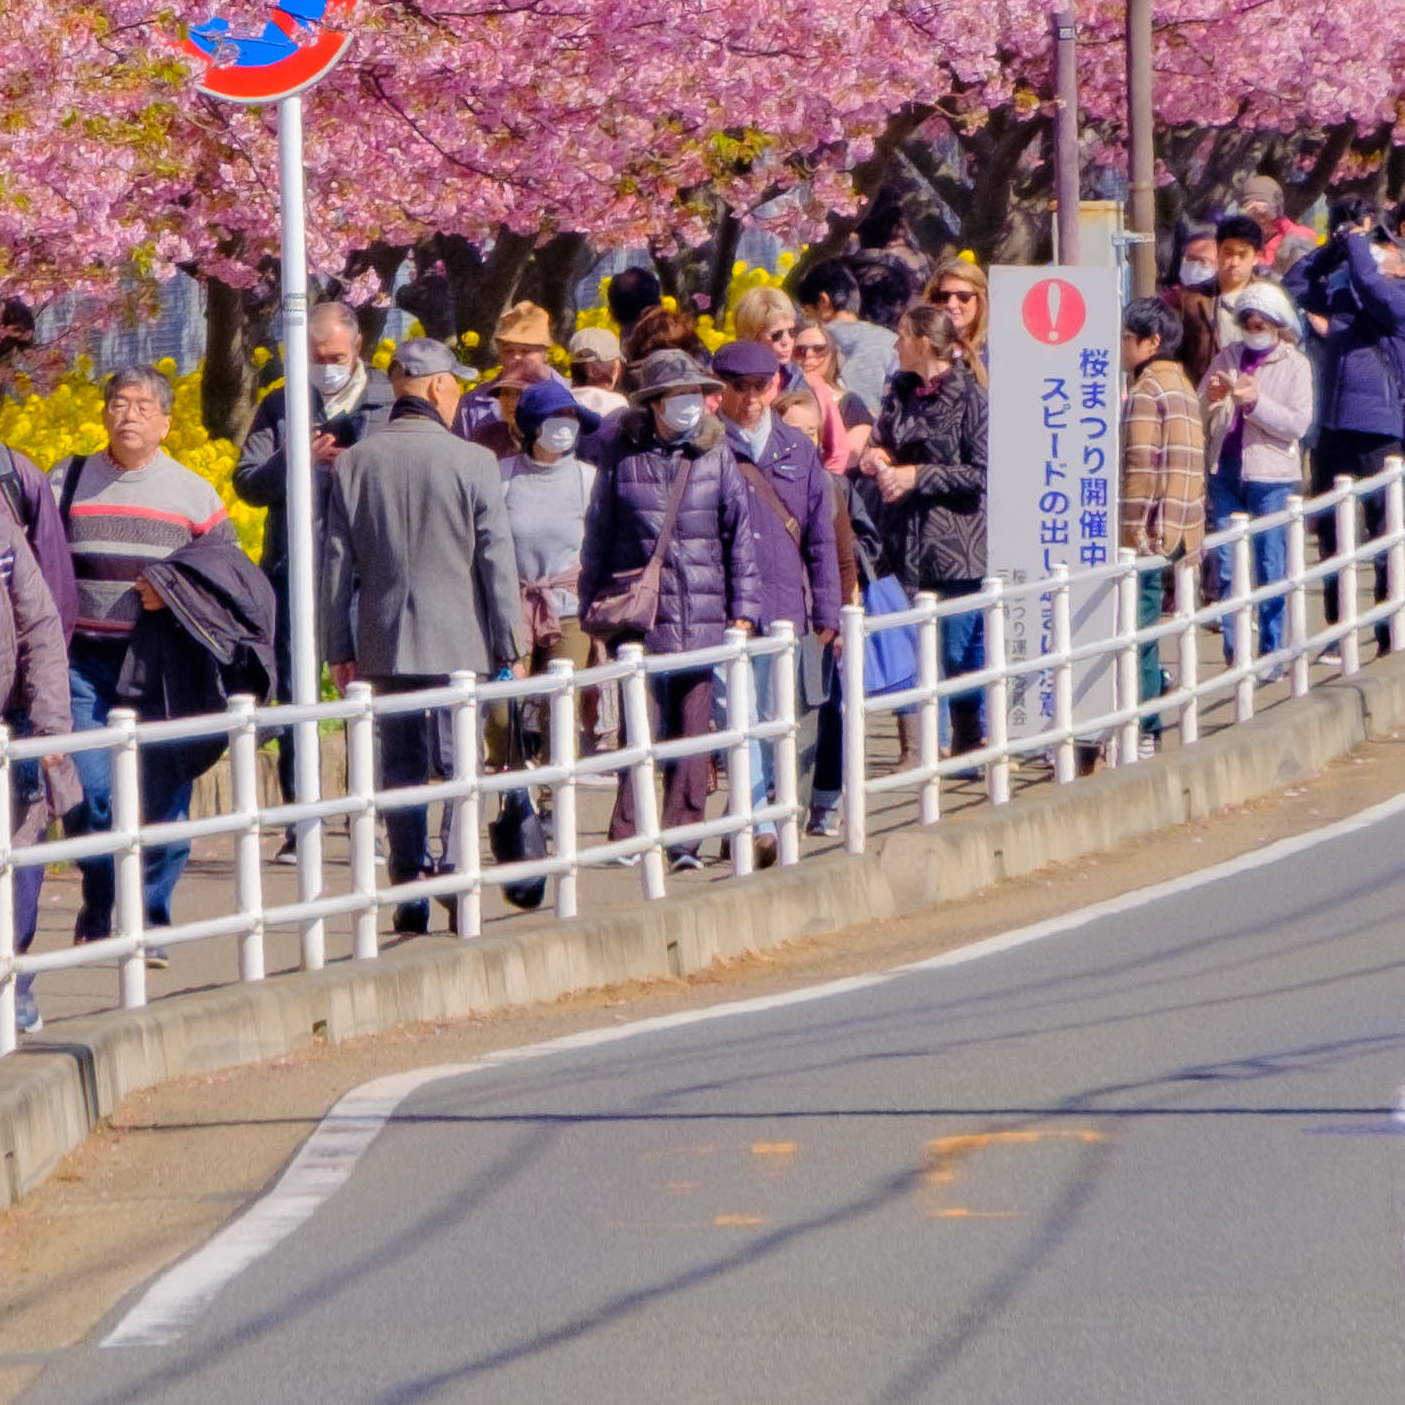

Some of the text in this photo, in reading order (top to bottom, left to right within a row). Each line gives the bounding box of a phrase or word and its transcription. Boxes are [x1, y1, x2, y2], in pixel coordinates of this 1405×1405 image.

[1038, 377, 1072, 718] スピードの出し
[1079, 347, 1110, 569] 桜まつり開催中
[1010, 568, 1028, 727] 桜つり運委員会
